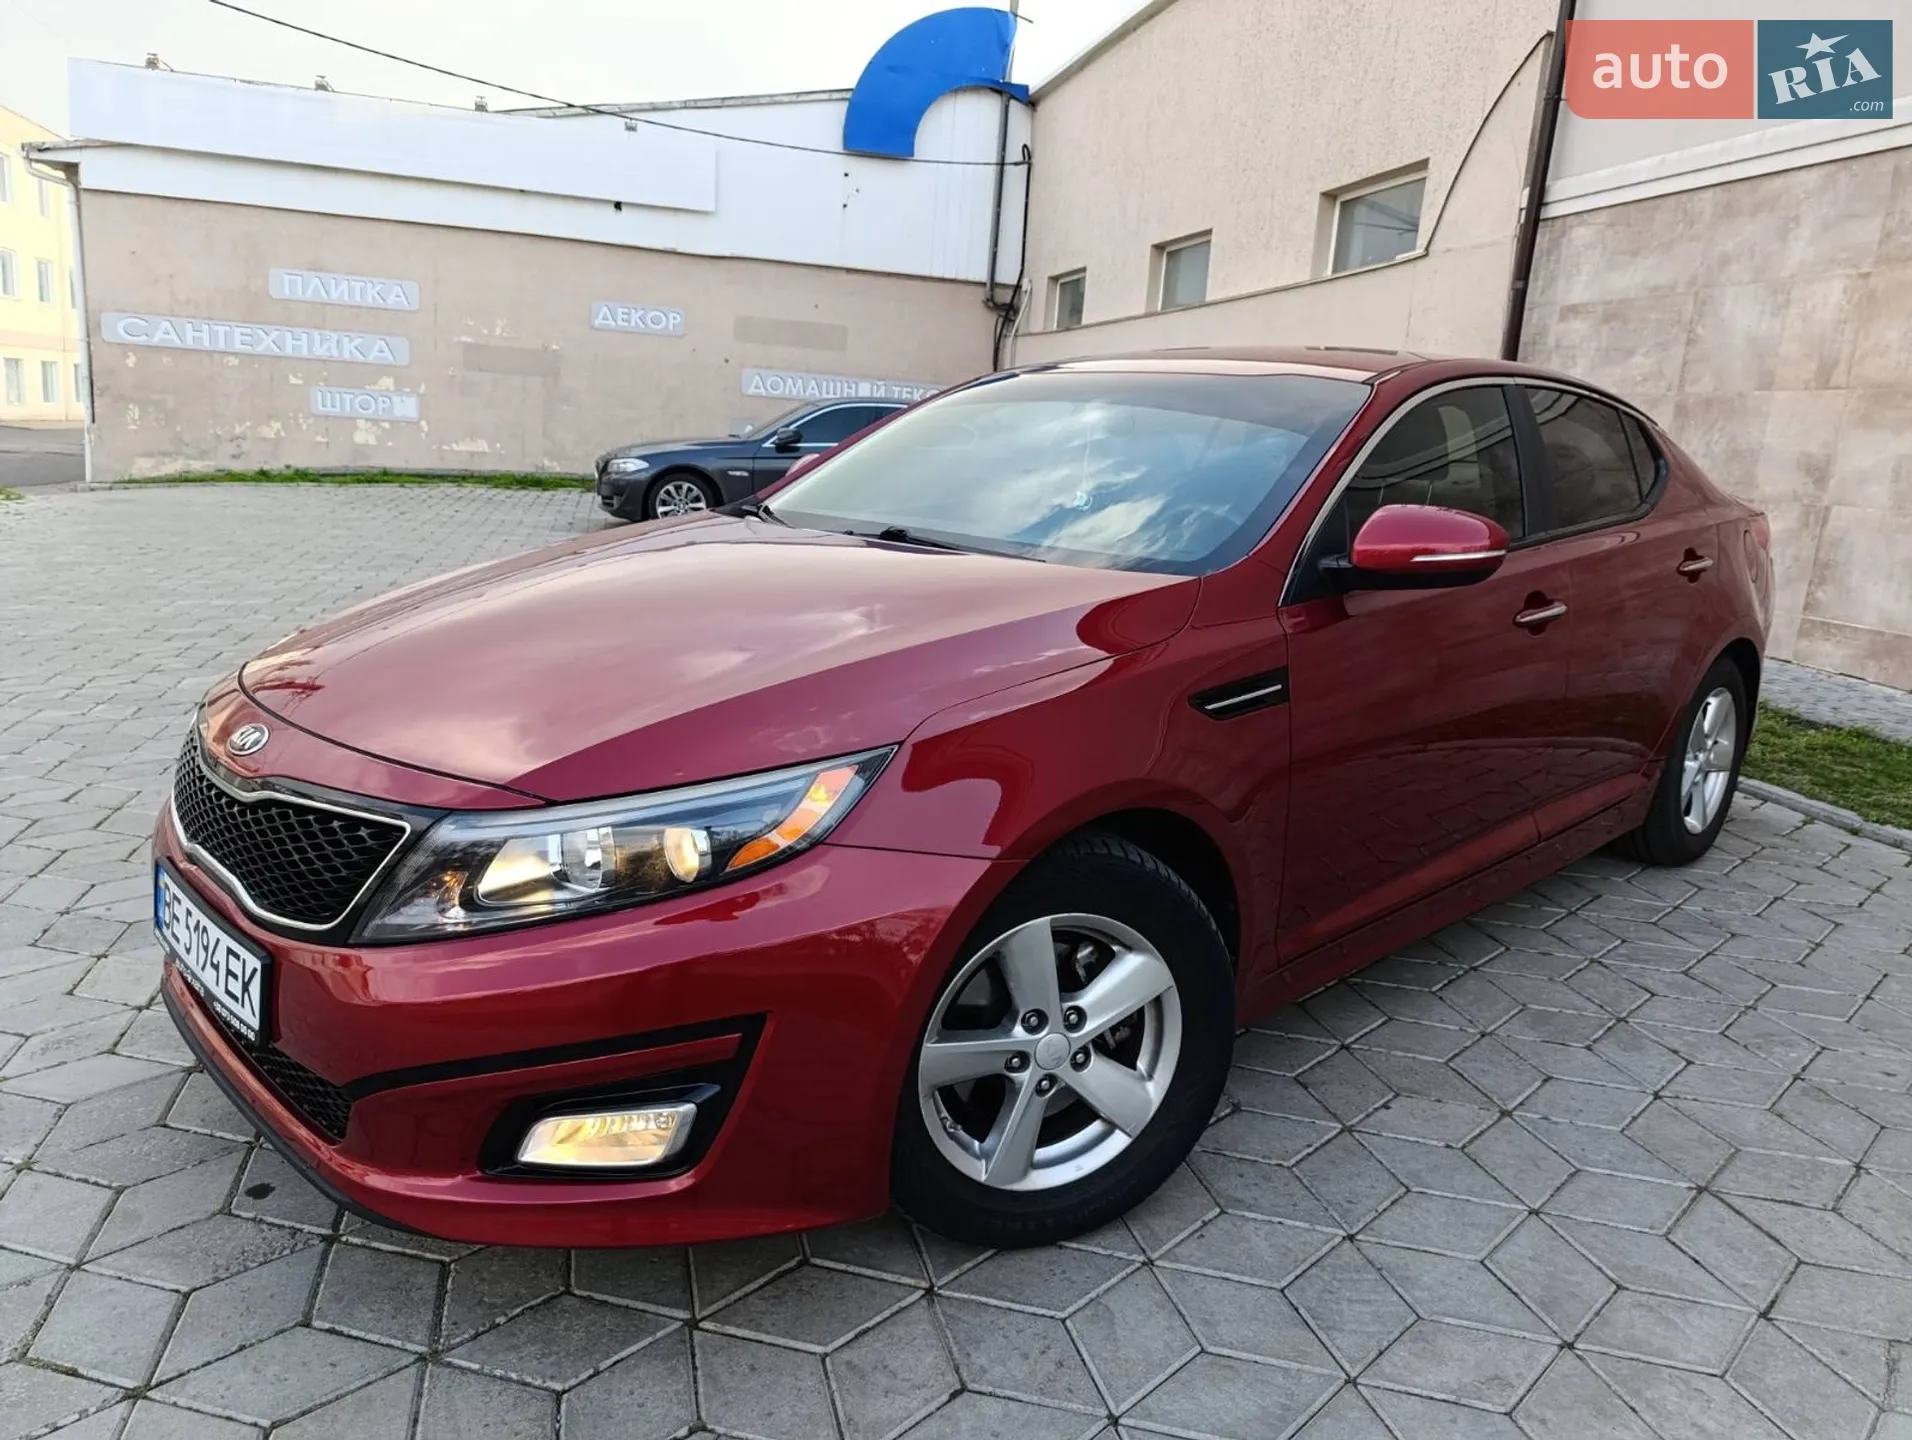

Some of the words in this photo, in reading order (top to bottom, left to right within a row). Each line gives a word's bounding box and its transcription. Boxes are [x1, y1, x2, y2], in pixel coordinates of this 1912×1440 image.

[282, 273, 411, 307] ПЛИТКА
[594, 304, 682, 331] ДЕКОР
[116, 318, 397, 363] САНТЕХНИКА
[748, 373, 886, 399] ДОМАШНЙ
[317, 389, 415, 416] ШТОР
[224, 945, 258, 1018] EK
